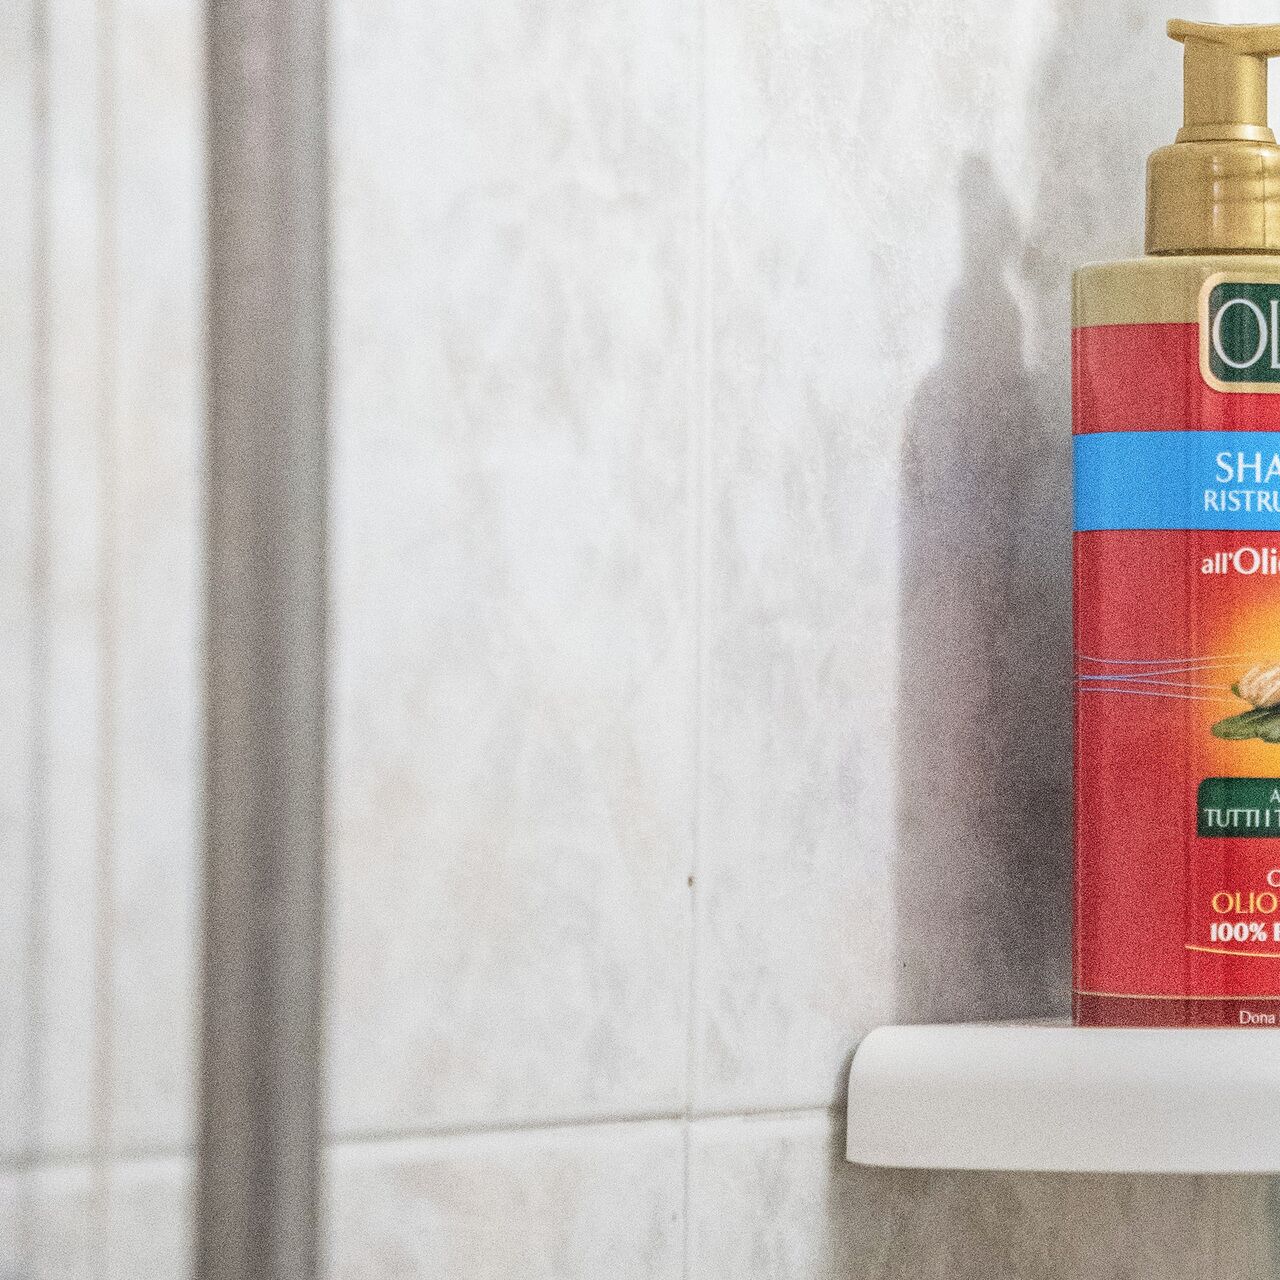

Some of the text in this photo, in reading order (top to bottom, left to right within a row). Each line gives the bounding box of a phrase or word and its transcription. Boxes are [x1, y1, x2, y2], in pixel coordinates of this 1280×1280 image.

[1204, 808, 1259, 828] TUTTI
[1265, 809, 1270, 828] I
[1211, 891, 1278, 914] OLIO
[1209, 922, 1267, 942] 100%
[1239, 1010, 1276, 1024] Dona
